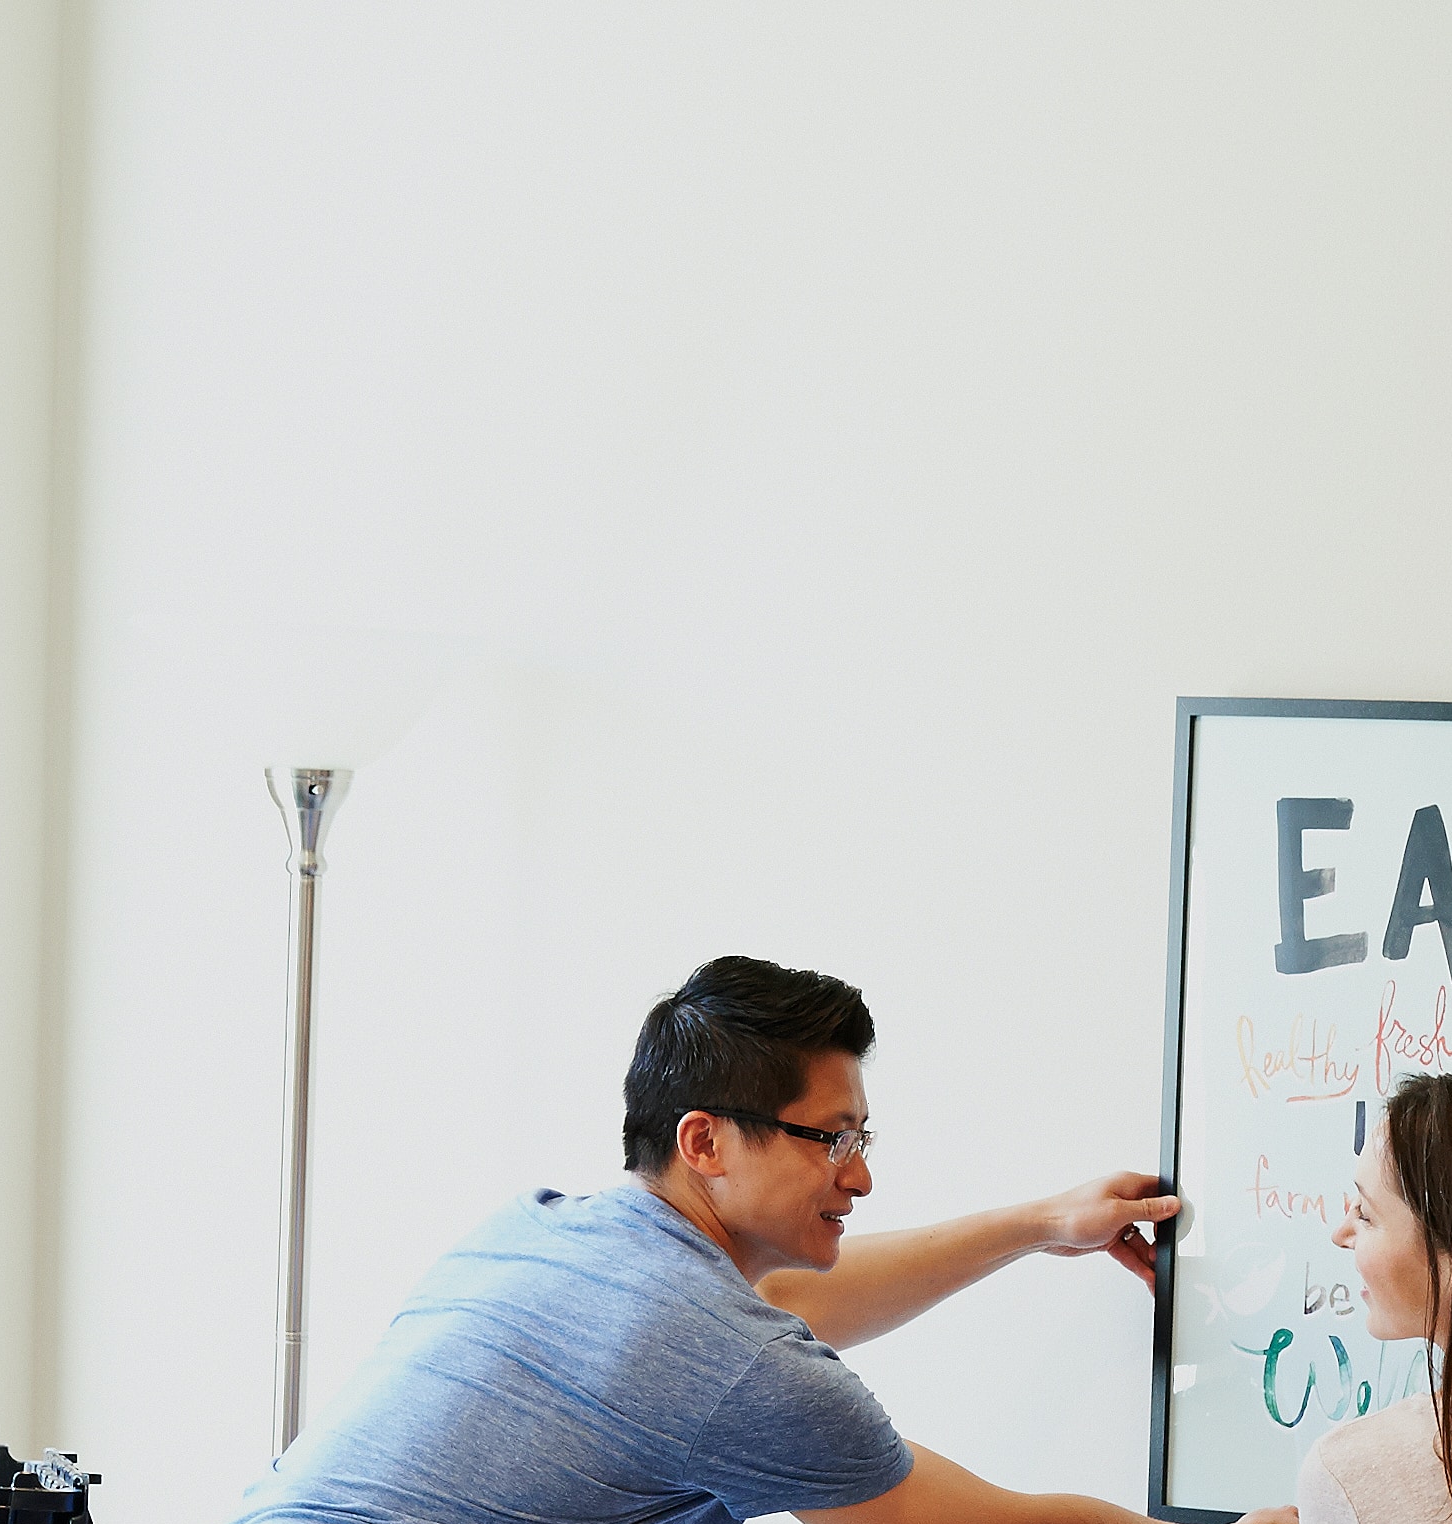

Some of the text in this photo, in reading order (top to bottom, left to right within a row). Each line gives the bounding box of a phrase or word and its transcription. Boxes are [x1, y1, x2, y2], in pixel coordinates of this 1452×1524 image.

[1237, 1012, 1359, 1102] healthy
[1246, 1155, 1327, 1224] farm
[1304, 1262, 1354, 1314] be
